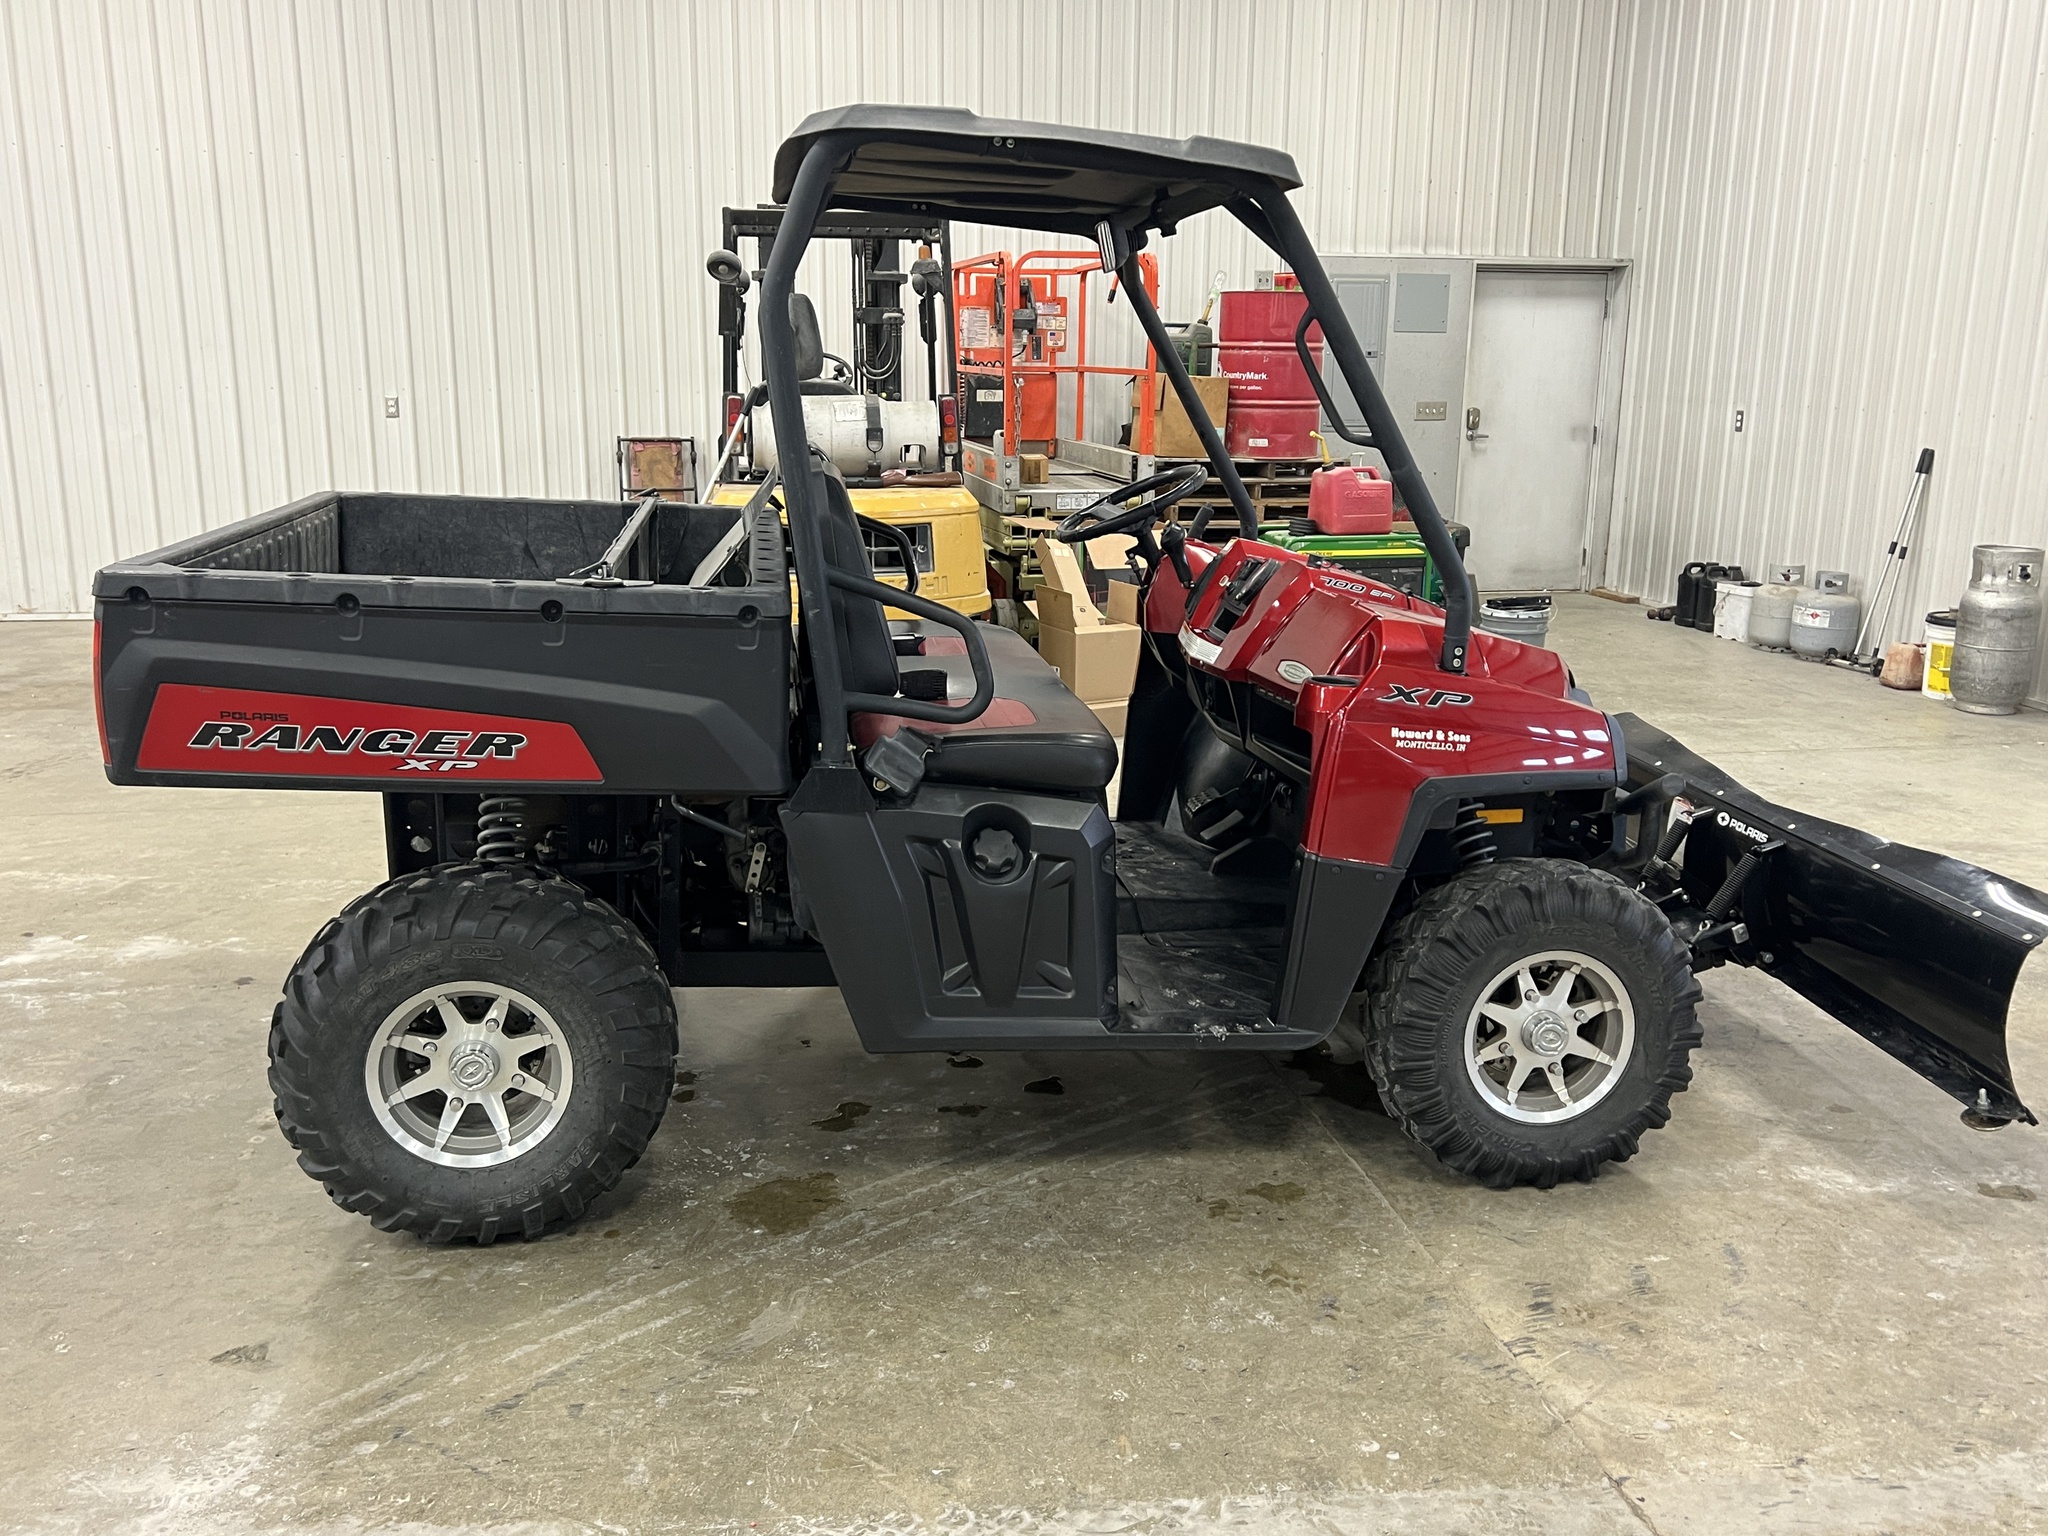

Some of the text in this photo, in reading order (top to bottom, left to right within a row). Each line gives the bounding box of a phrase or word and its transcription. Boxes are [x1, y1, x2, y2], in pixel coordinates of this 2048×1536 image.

[1223, 371, 1268, 381] CountryMark
[1344, 490, 1388, 499] GASOLINE
[1319, 575, 1396, 601] 700 EFI
[1377, 684, 1474, 708] XP
[220, 711, 289, 723] POLARIS
[187, 721, 529, 759] RANGER
[1390, 726, 1471, 743] Howard & Sons
[1395, 739, 1467, 752] MONTICELLO, IN
[392, 758, 480, 773] XP
[1729, 817, 1769, 843] POLARIS
[477, 1136, 595, 1213] CARLISLE
